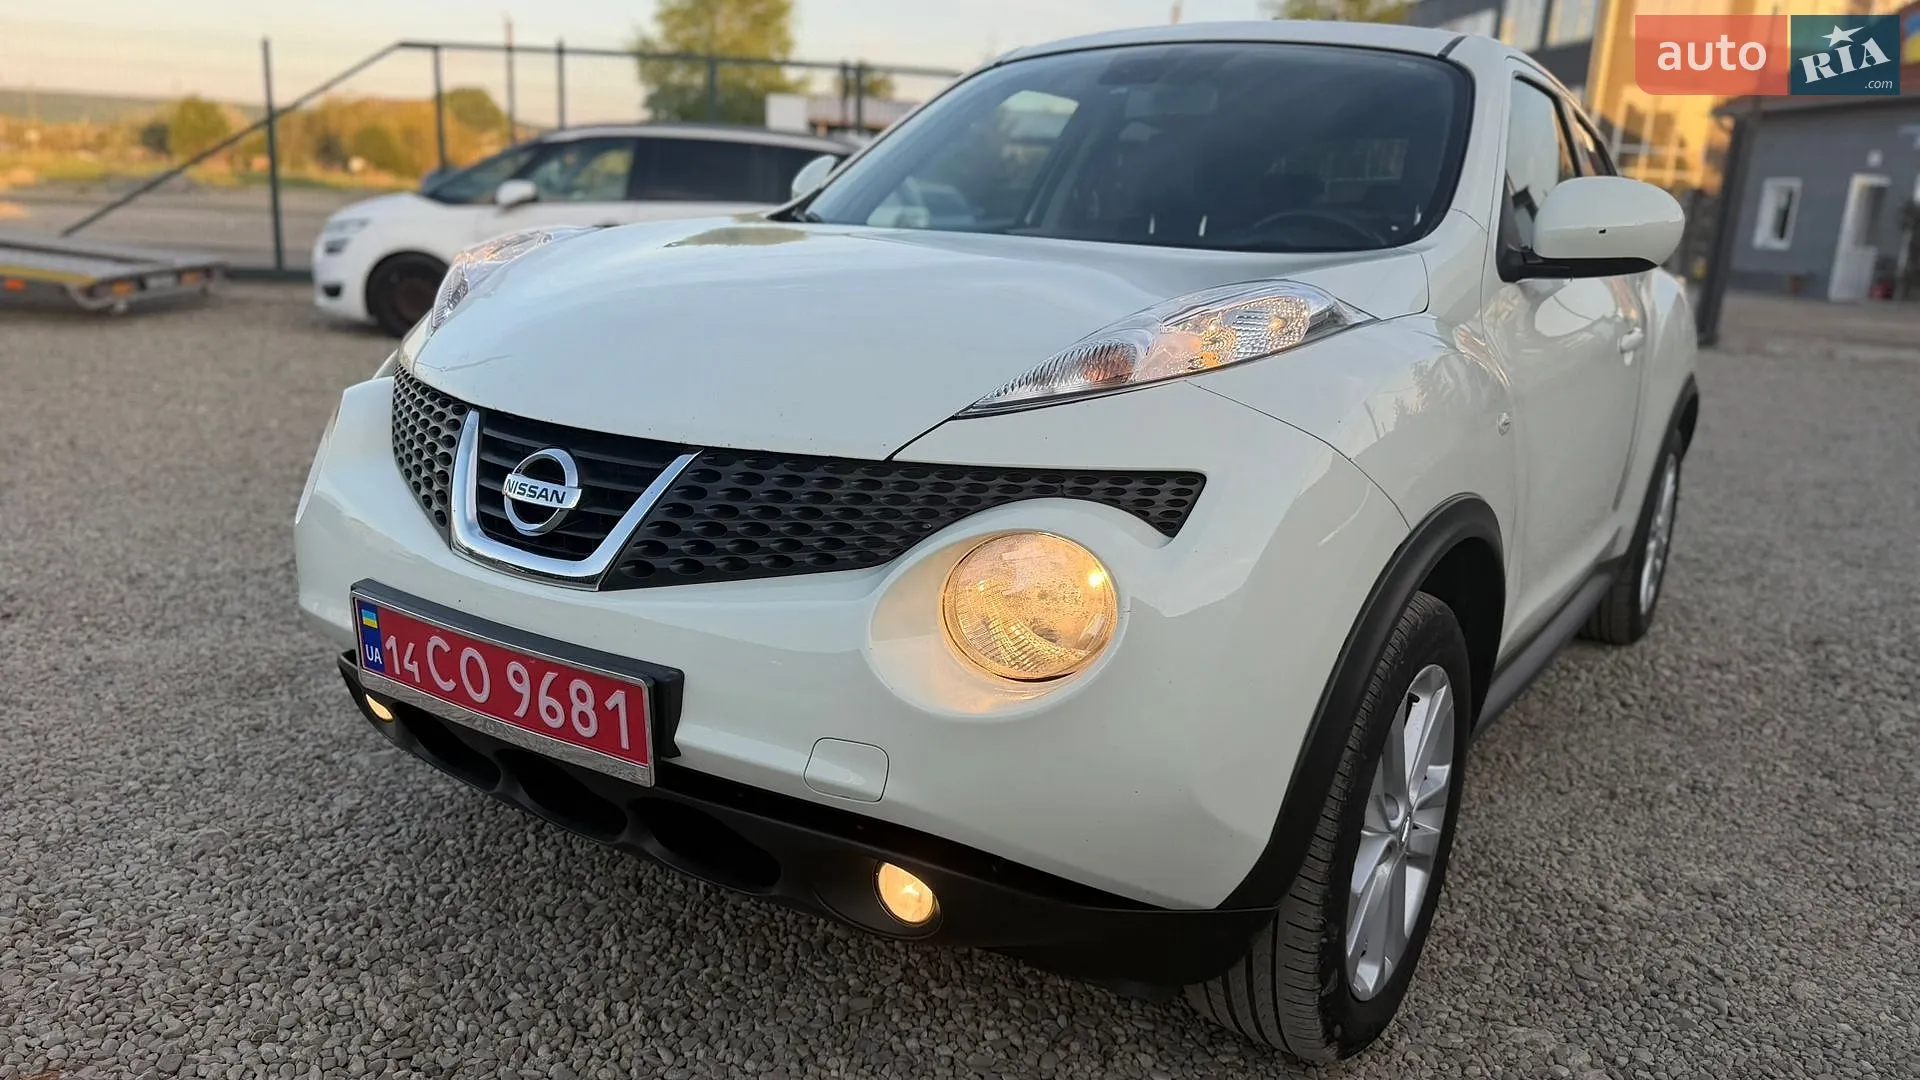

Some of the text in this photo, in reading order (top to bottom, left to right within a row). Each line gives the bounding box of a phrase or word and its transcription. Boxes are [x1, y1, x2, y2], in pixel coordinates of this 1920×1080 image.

[505, 478, 566, 504] NISSAN
[365, 645, 383, 665] UA
[506, 660, 630, 751] 9681
